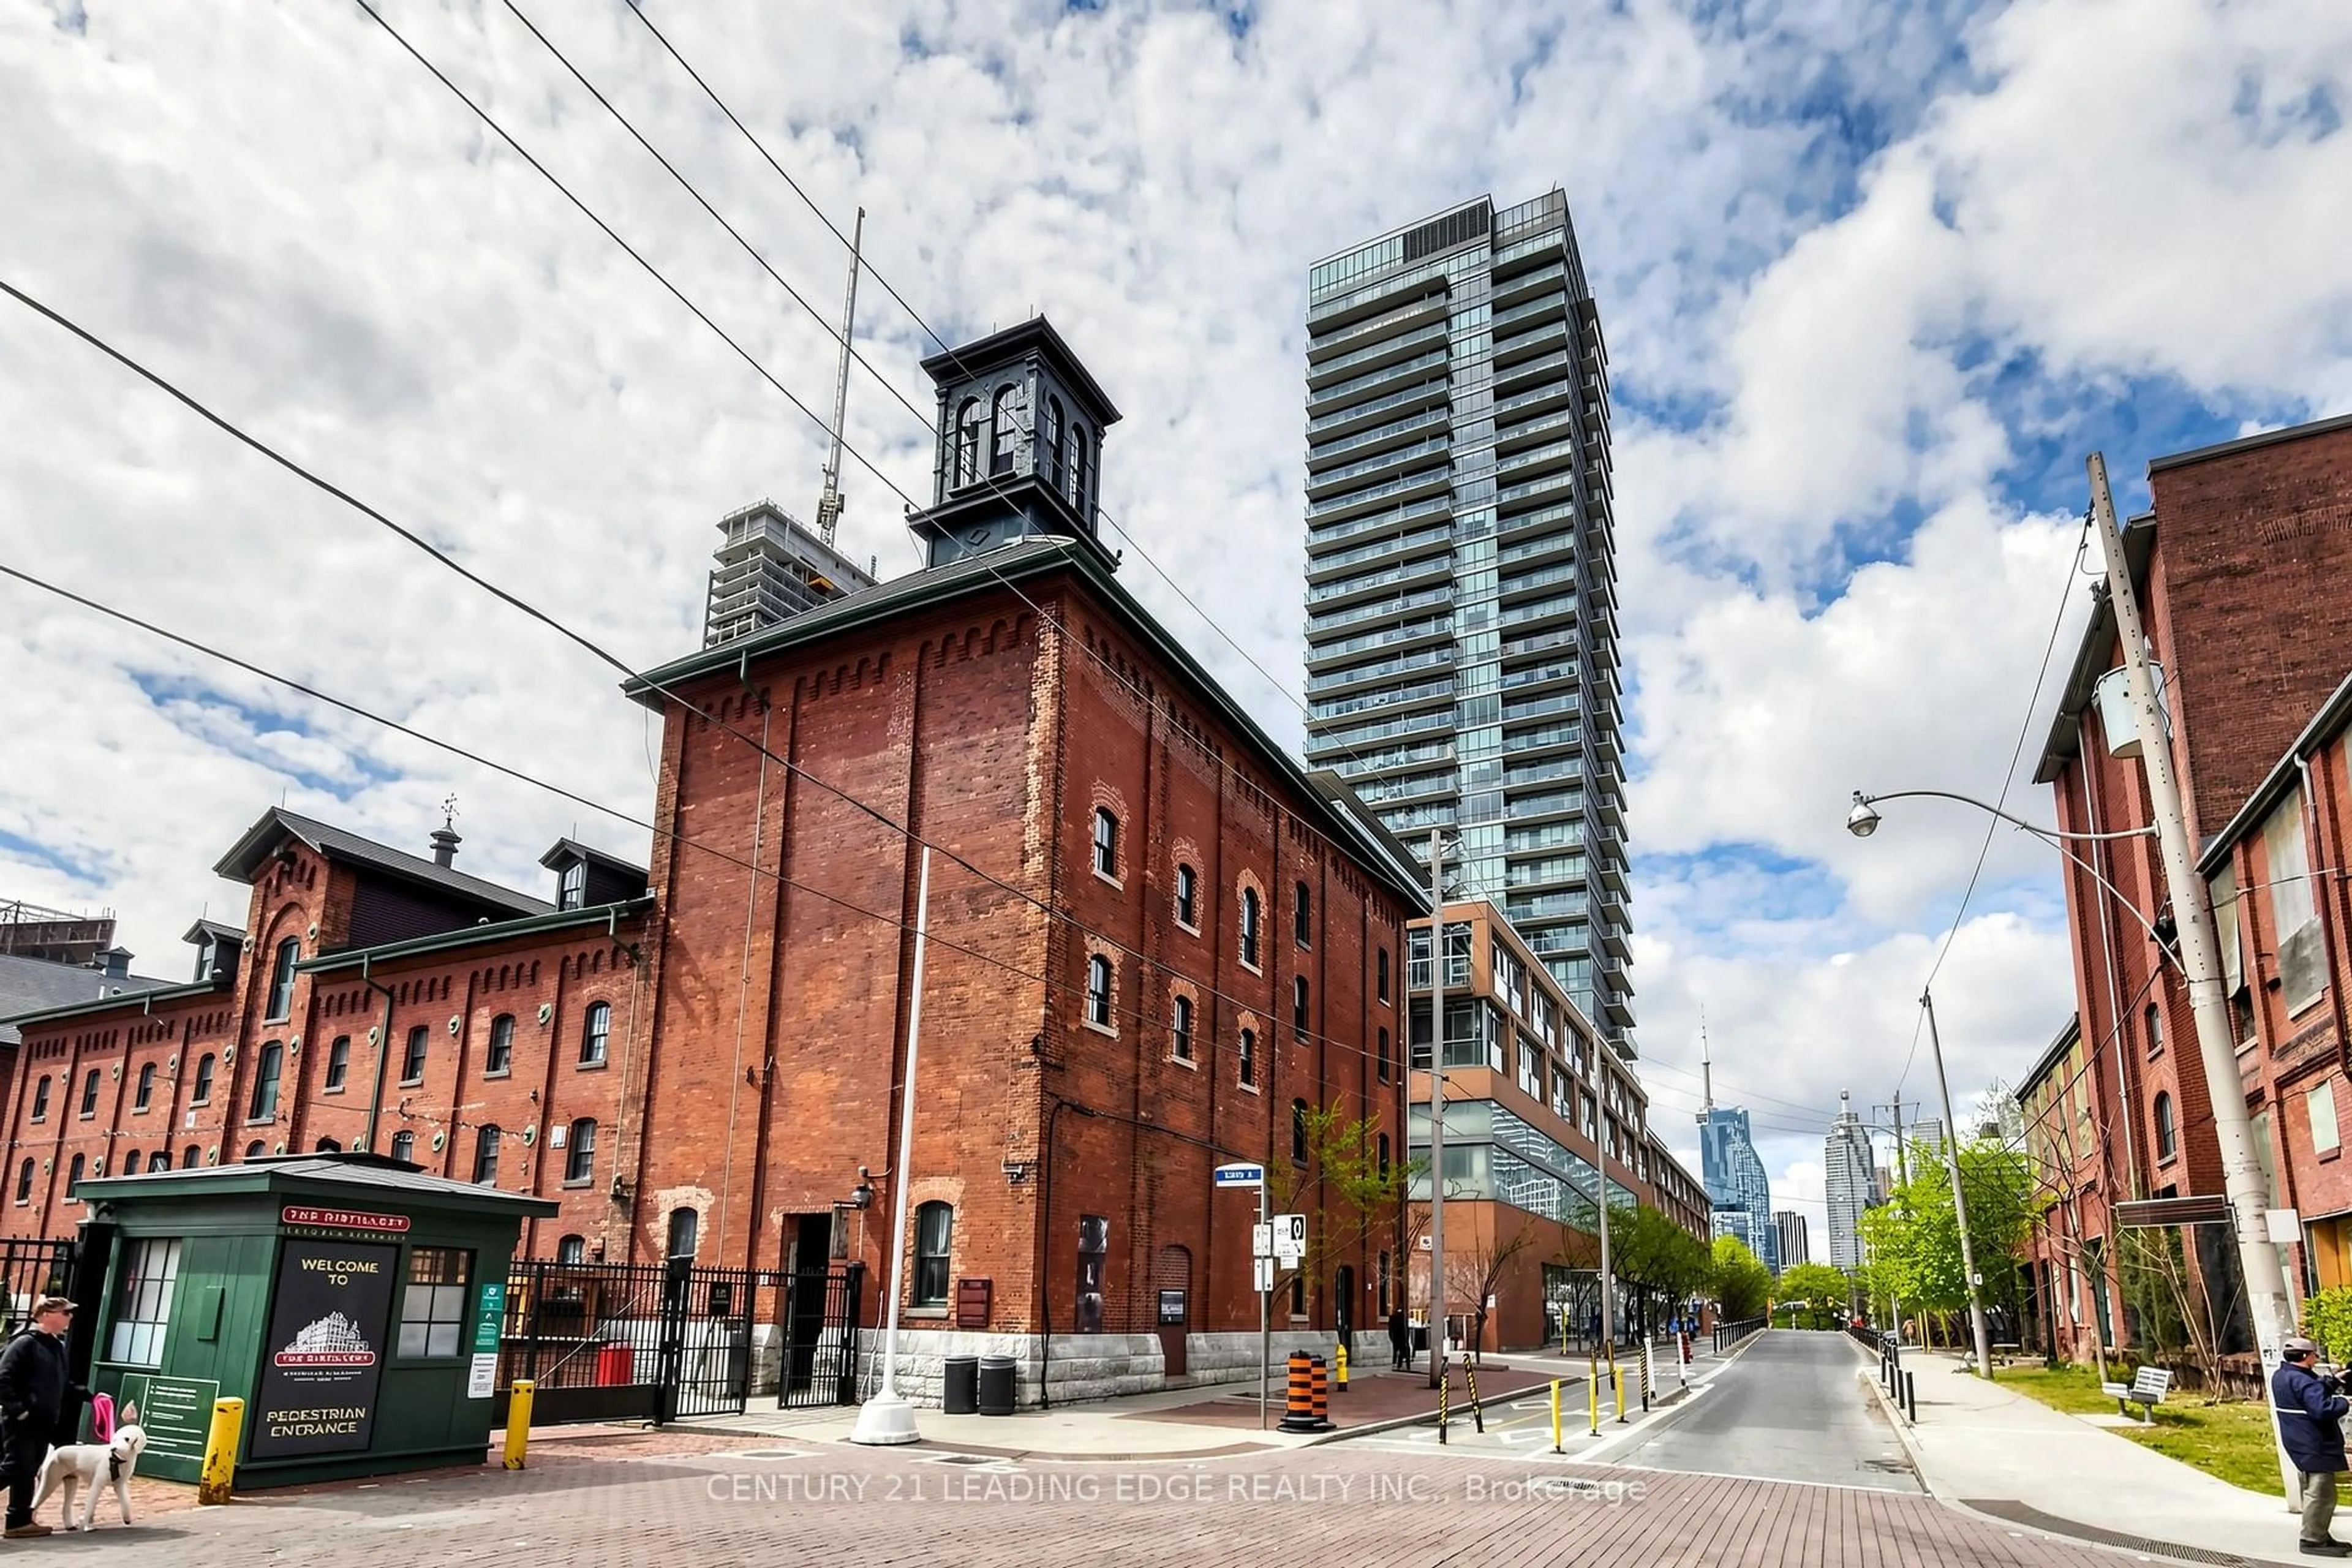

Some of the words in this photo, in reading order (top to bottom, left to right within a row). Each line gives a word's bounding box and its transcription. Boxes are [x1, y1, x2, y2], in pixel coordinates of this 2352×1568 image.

[301, 1259, 380, 1273] WELCOME
[328, 1274, 349, 1285] TO
[266, 1408, 366, 1422] PEDESTRIAN
